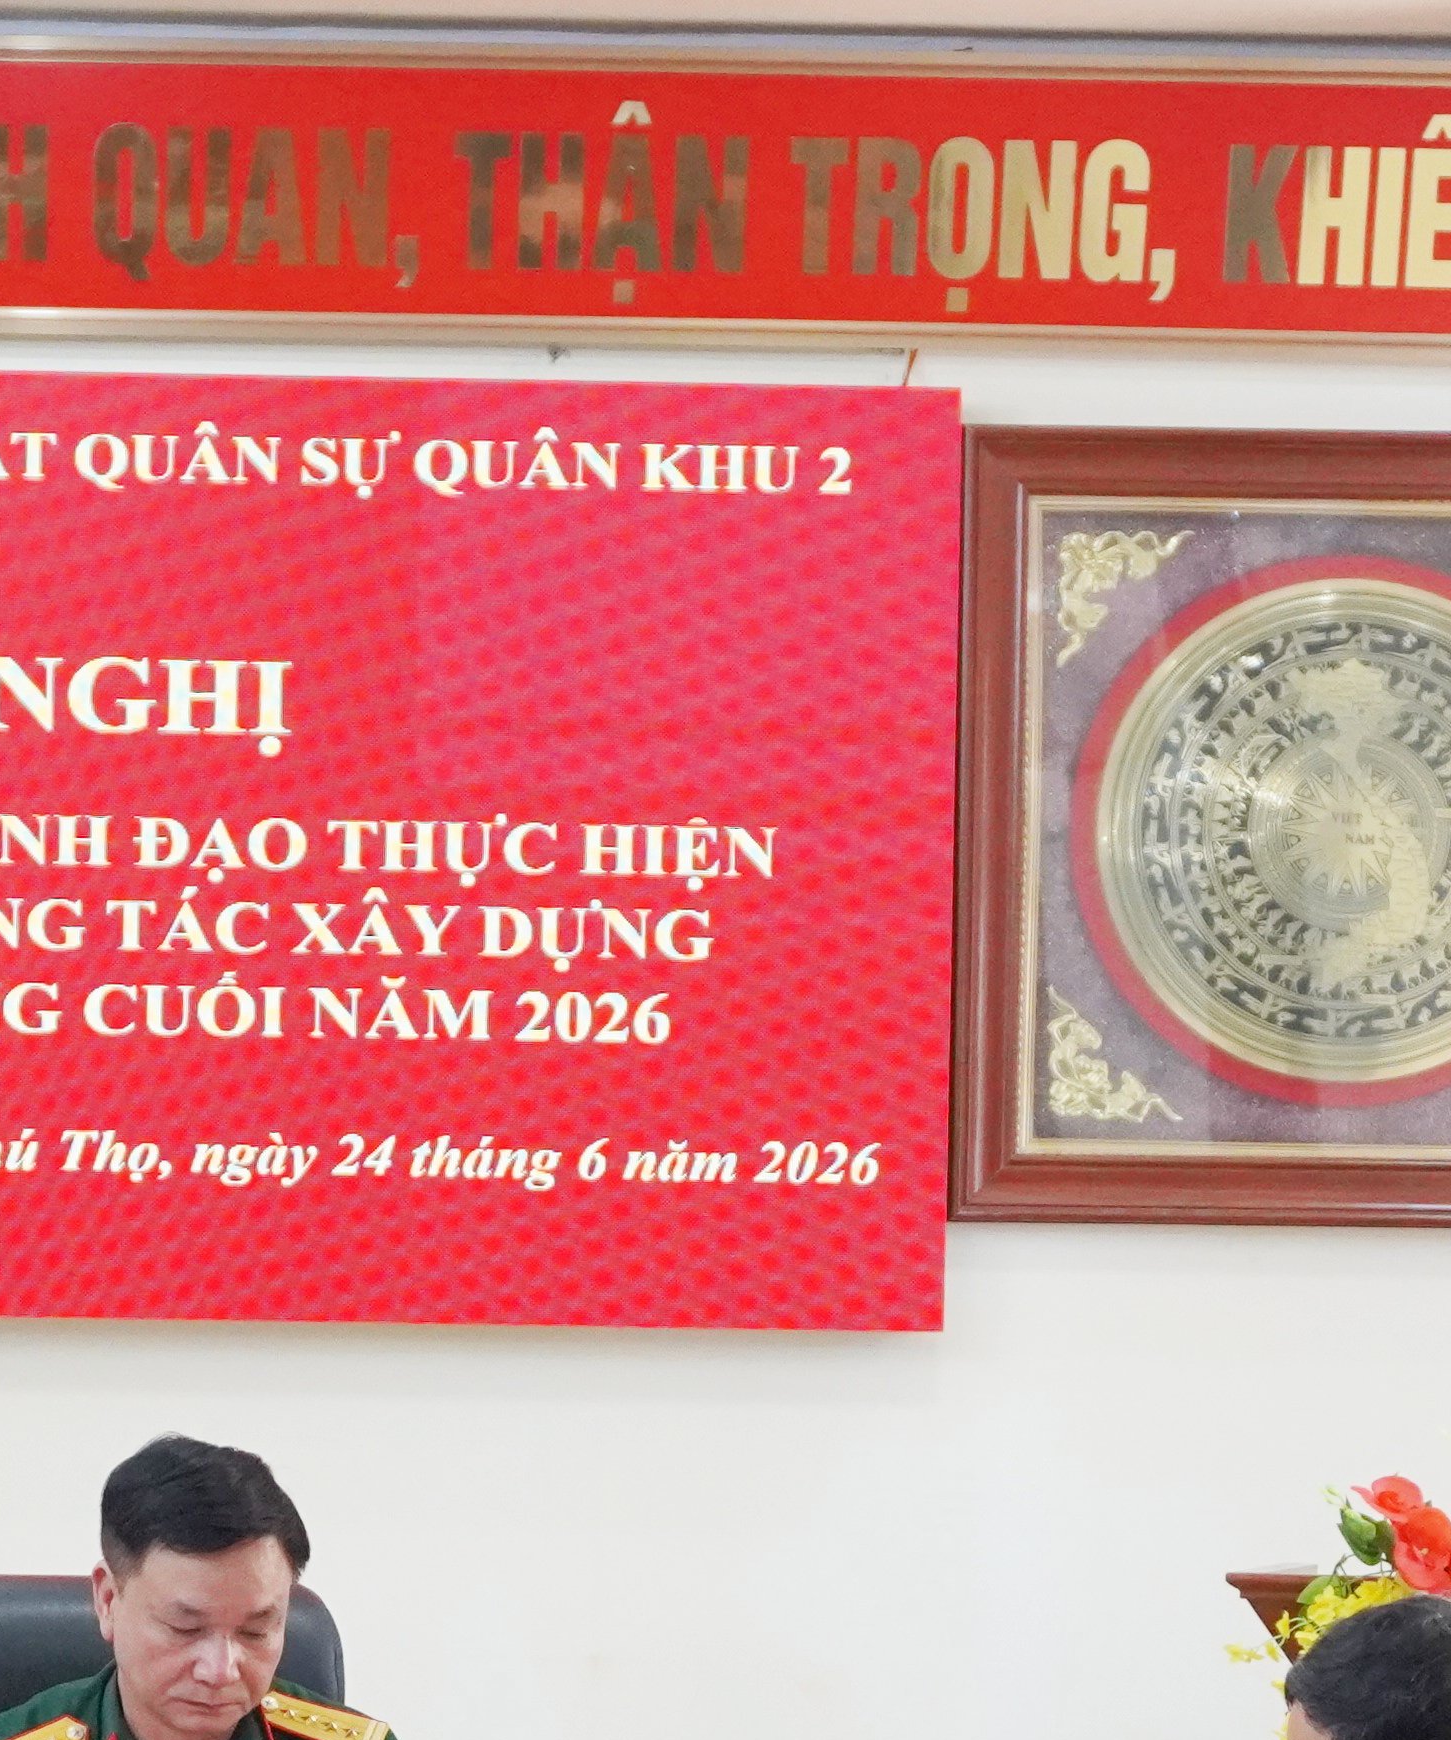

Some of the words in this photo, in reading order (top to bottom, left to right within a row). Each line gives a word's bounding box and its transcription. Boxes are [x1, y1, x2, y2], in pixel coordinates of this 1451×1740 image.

[93, 121, 419, 288] QUAN,
[454, 100, 751, 304] THẬN
[789, 135, 1177, 313] TRỌNG,
[73, 420, 282, 492] QUÂN
[300, 430, 402, 500] SỰ
[413, 426, 622, 498] QUÂN
[641, 443, 801, 494] KHU
[818, 446, 852, 495] 2
[132, 815, 308, 884] ĐẠO
[326, 813, 558, 892] THỰC
[579, 816, 779, 893] HIỆN
[105, 885, 270, 956] TÁC
[291, 886, 461, 957] XÂY
[477, 898, 715, 973] DỰNG
[83, 971, 286, 1038] CUỐI
[307, 975, 493, 1042] NĂM
[514, 990, 671, 1045] 2026
[60, 1129, 173, 1183] Thọ,
[190, 1131, 319, 1186] ngày
[330, 1133, 396, 1177] 24
[409, 1134, 563, 1192] tháng
[577, 1137, 610, 1181] 6
[622, 1141, 738, 1184] năm
[753, 1140, 882, 1186] 2026
